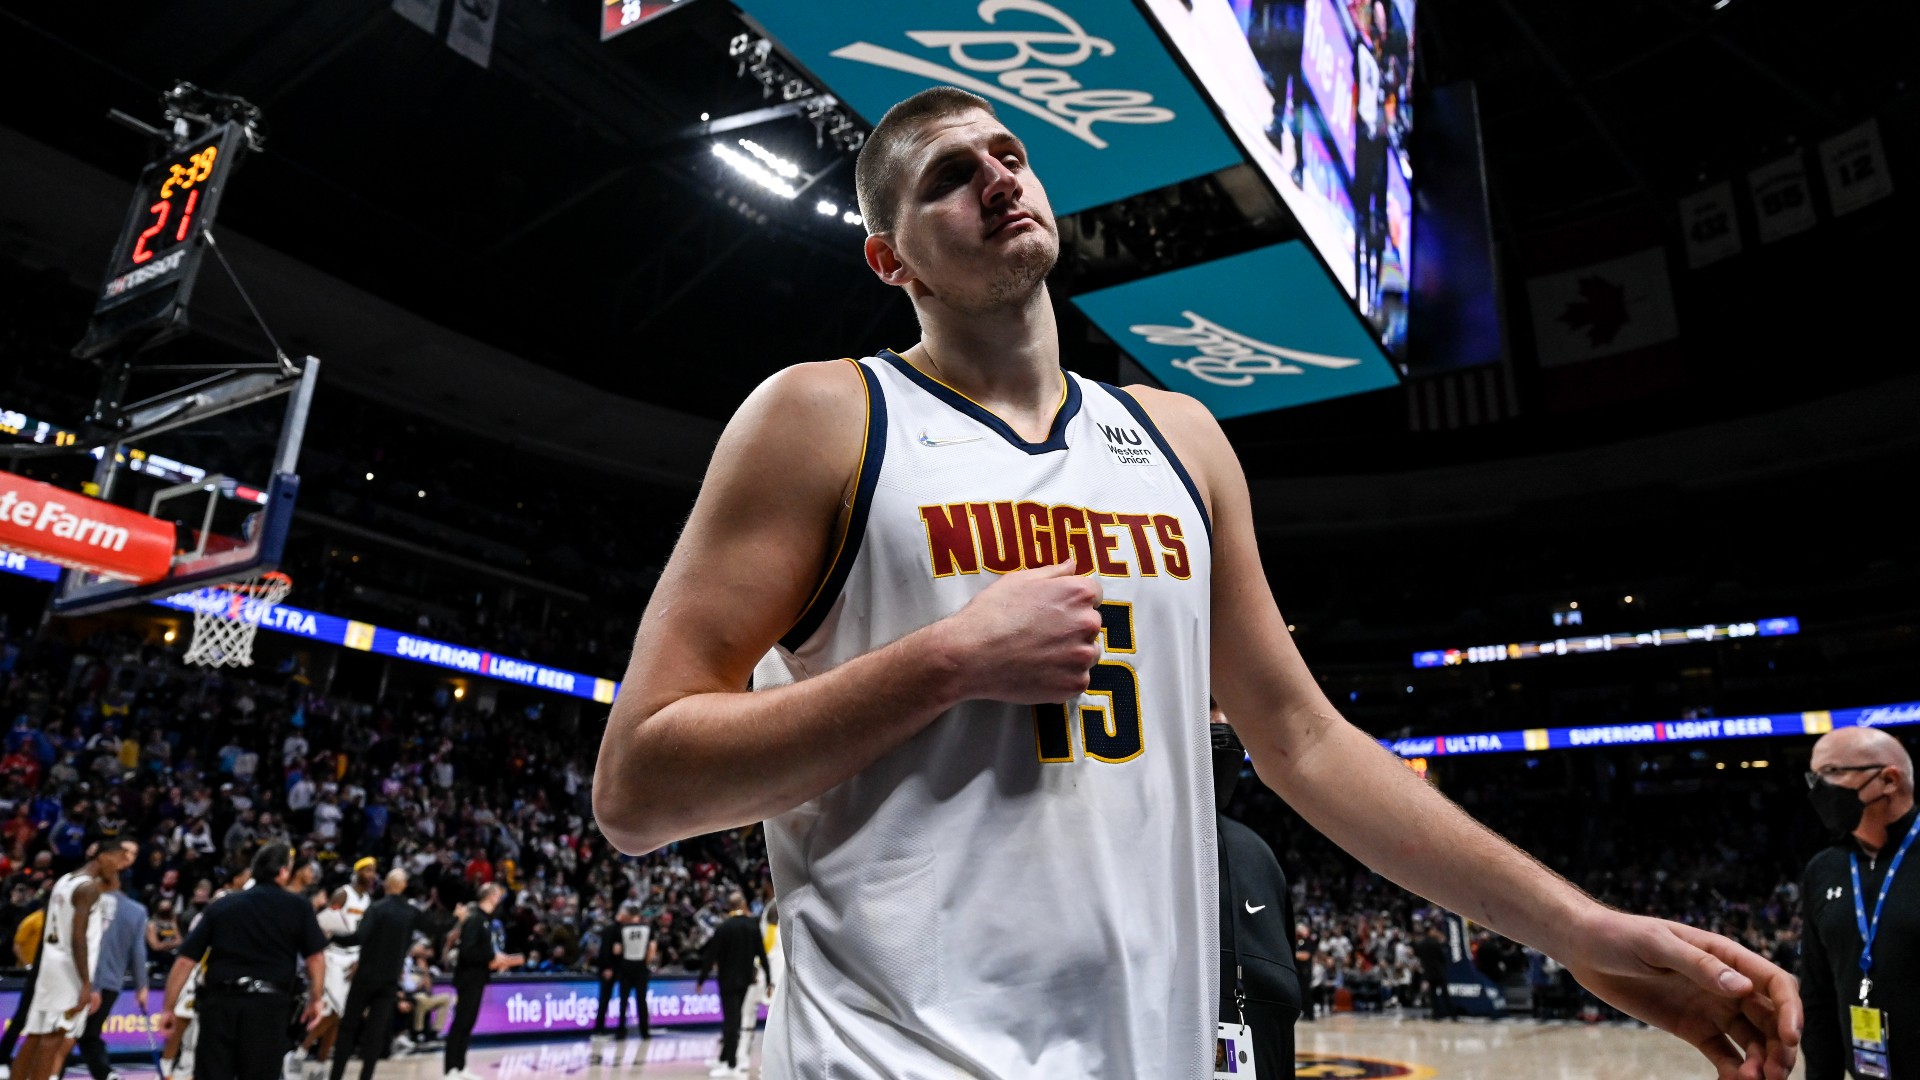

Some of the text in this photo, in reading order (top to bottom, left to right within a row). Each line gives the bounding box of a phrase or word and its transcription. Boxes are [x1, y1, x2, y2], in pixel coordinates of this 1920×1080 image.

[830, 0, 1176, 149] Ball
[161, 146, 217, 198] 2:39
[132, 189, 198, 263] 21
[1096, 422, 1142, 446] WU
[1107, 443, 1152, 456] Western
[1117, 455, 1150, 464] Union
[919, 501, 1192, 580] NUGGETS
[244, 599, 317, 635] ULTRA
[397, 636, 576, 692] SUPERIOR LIGHT BEER
[1034, 600, 1145, 764] 5
[1445, 734, 1502, 753] ULTRA
[1568, 717, 1772, 745] SUPERIOR LIGHT BEER
[506, 991, 542, 1024] the
[647, 988, 680, 1016] free
[681, 993, 721, 1016] zone
